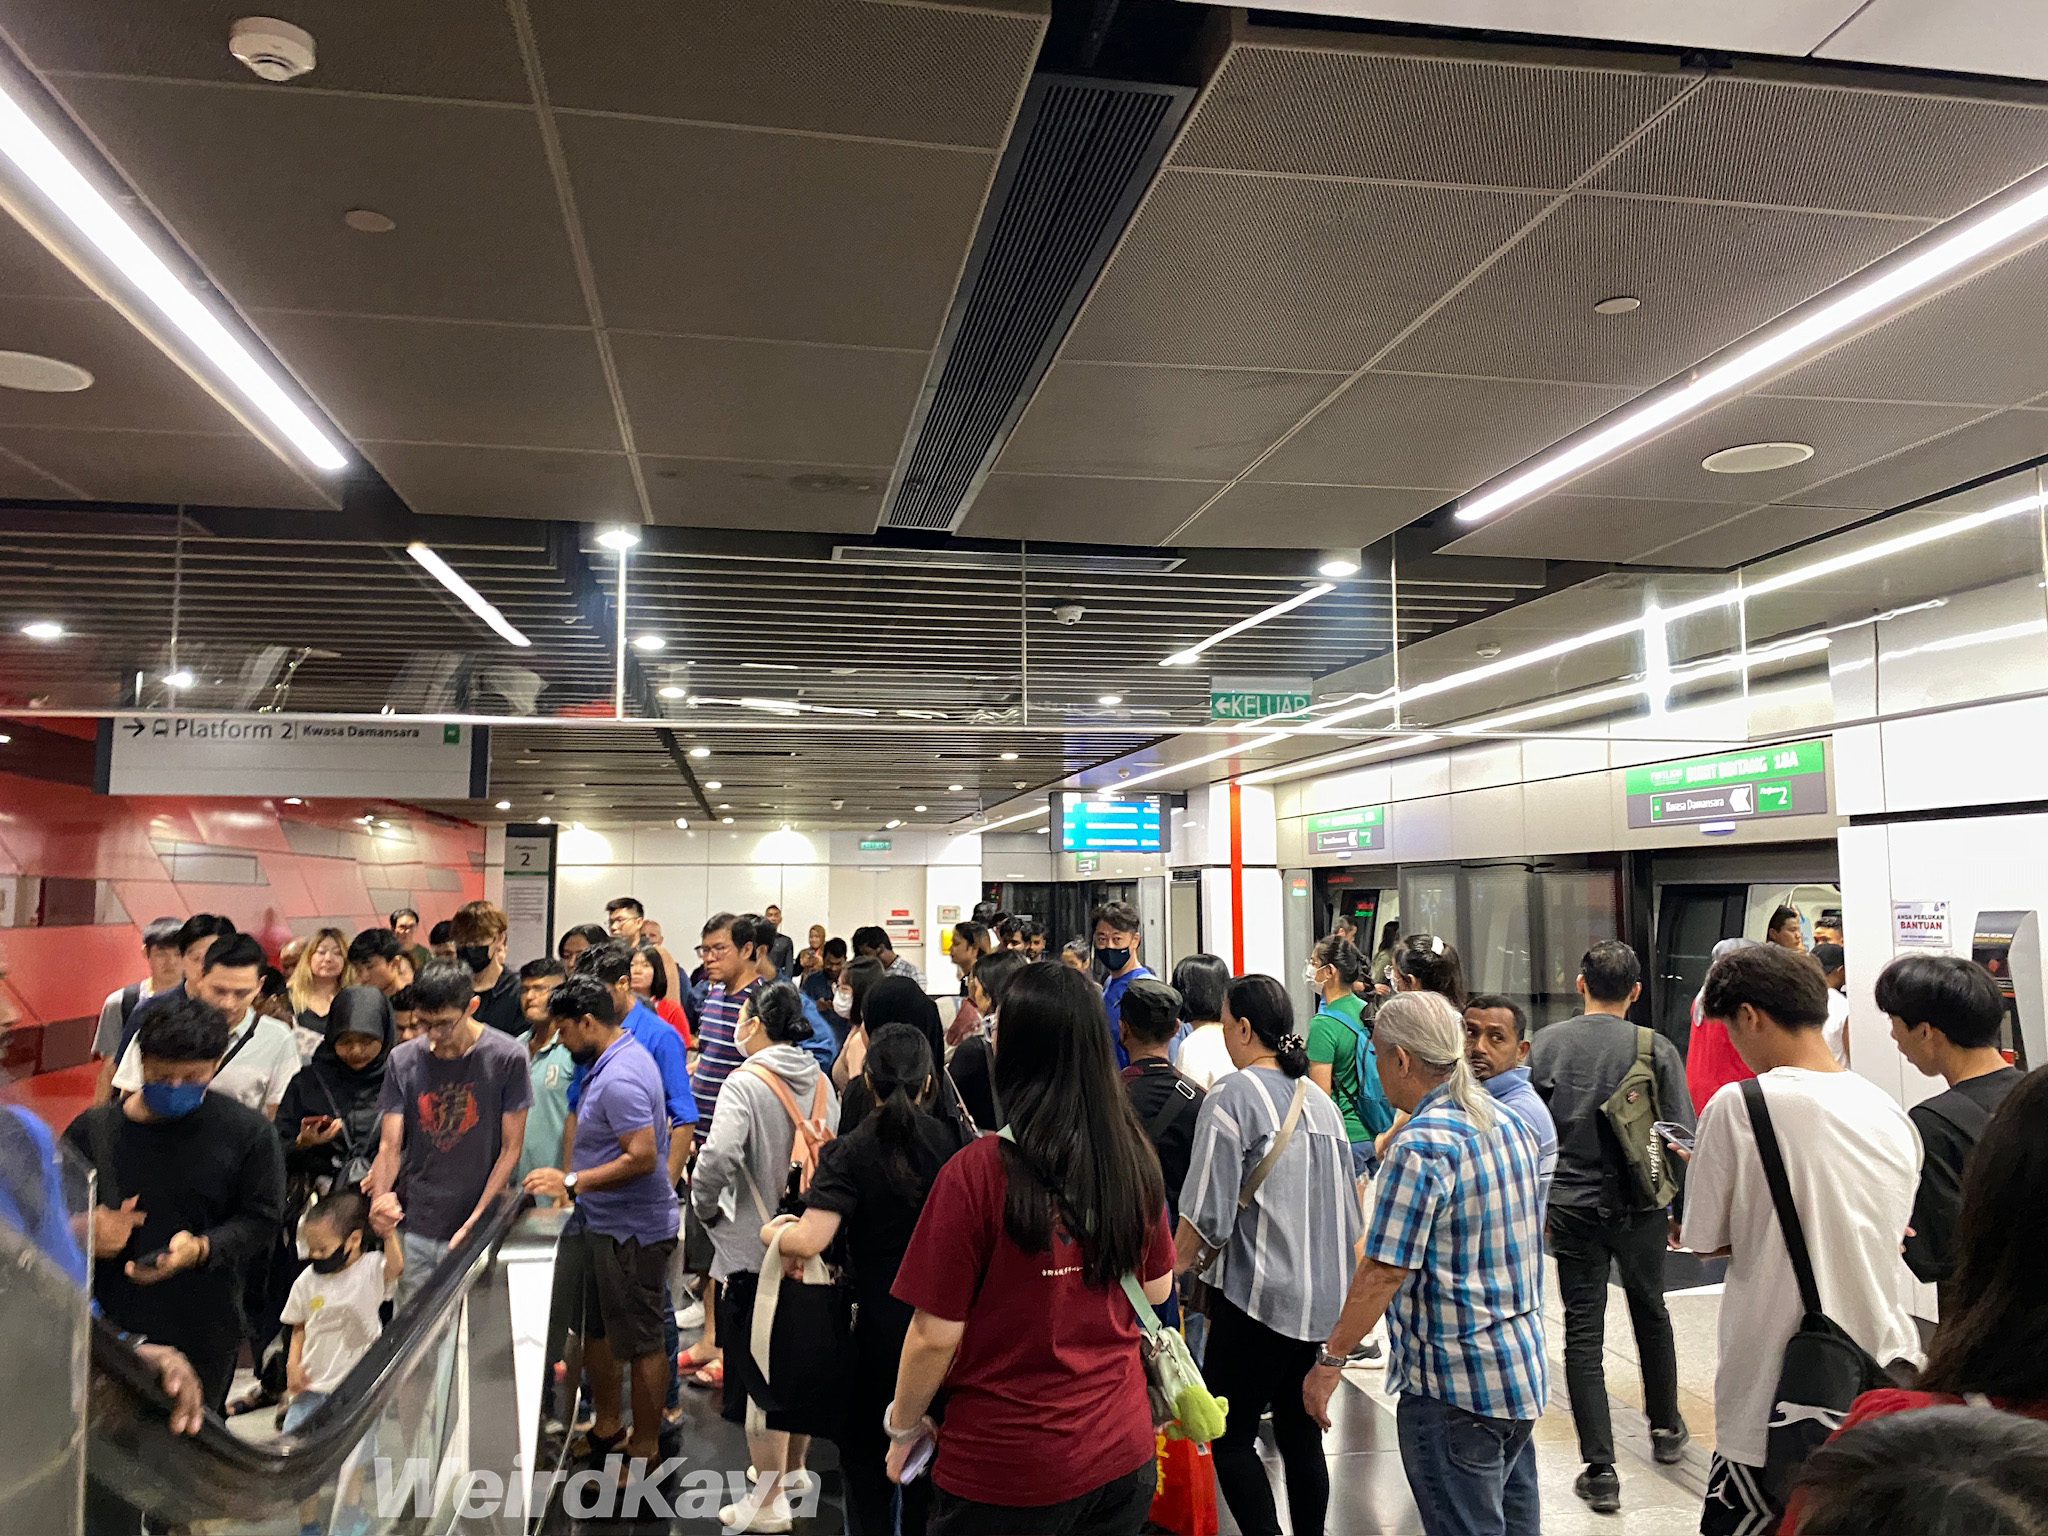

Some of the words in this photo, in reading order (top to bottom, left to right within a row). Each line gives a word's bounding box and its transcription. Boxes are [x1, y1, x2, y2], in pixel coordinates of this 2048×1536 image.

[1231, 695, 1308, 718] KELUAR
[175, 719, 272, 739] Platform
[281, 722, 292, 739] 2
[303, 725, 344, 737] Kwasa
[347, 726, 419, 738] Damansara
[521, 853, 531, 866] 2
[1900, 921, 1942, 930] BANTUAN
